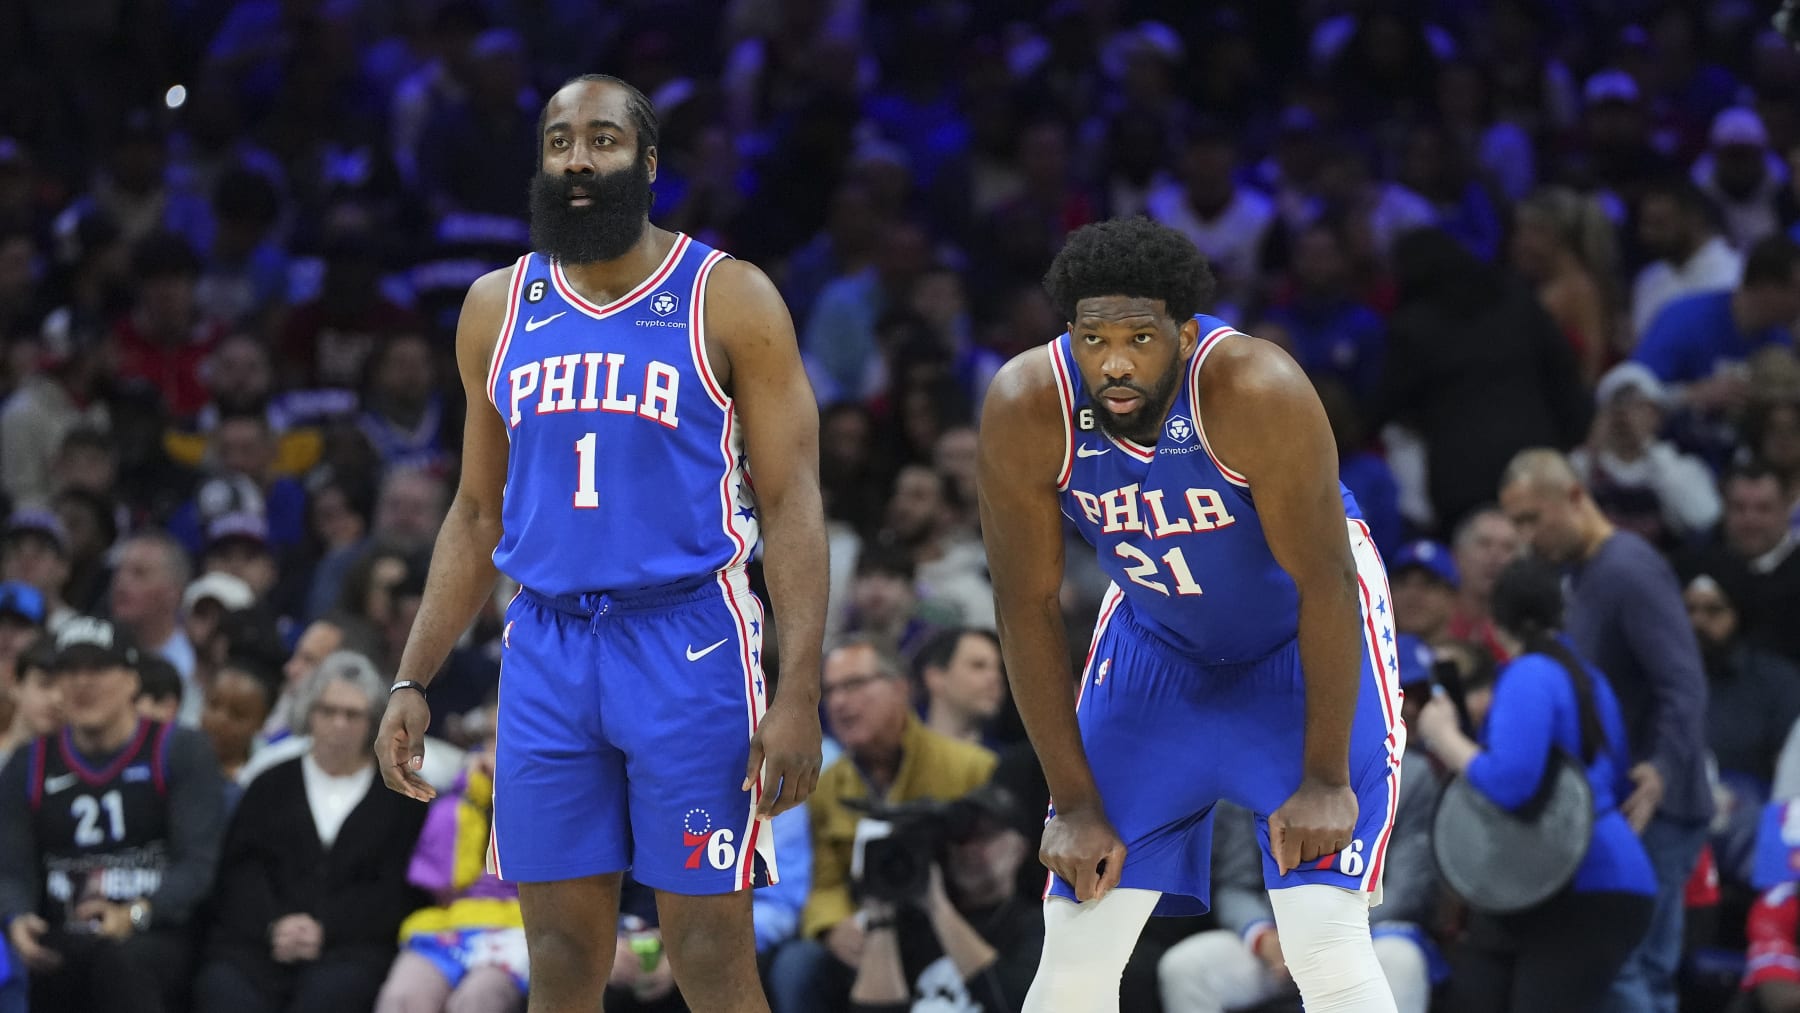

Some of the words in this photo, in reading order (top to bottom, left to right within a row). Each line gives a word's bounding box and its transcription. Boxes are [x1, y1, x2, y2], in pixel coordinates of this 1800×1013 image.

[529, 282, 545, 302] 6
[635, 319, 687, 329] crypto.com
[508, 352, 680, 430] PHILA
[1079, 408, 1095, 430] 6
[572, 432, 599, 509] 1
[1071, 482, 1236, 541] PHLA
[1114, 541, 1203, 597] 21
[71, 789, 125, 847] 21
[683, 828, 736, 870] 76
